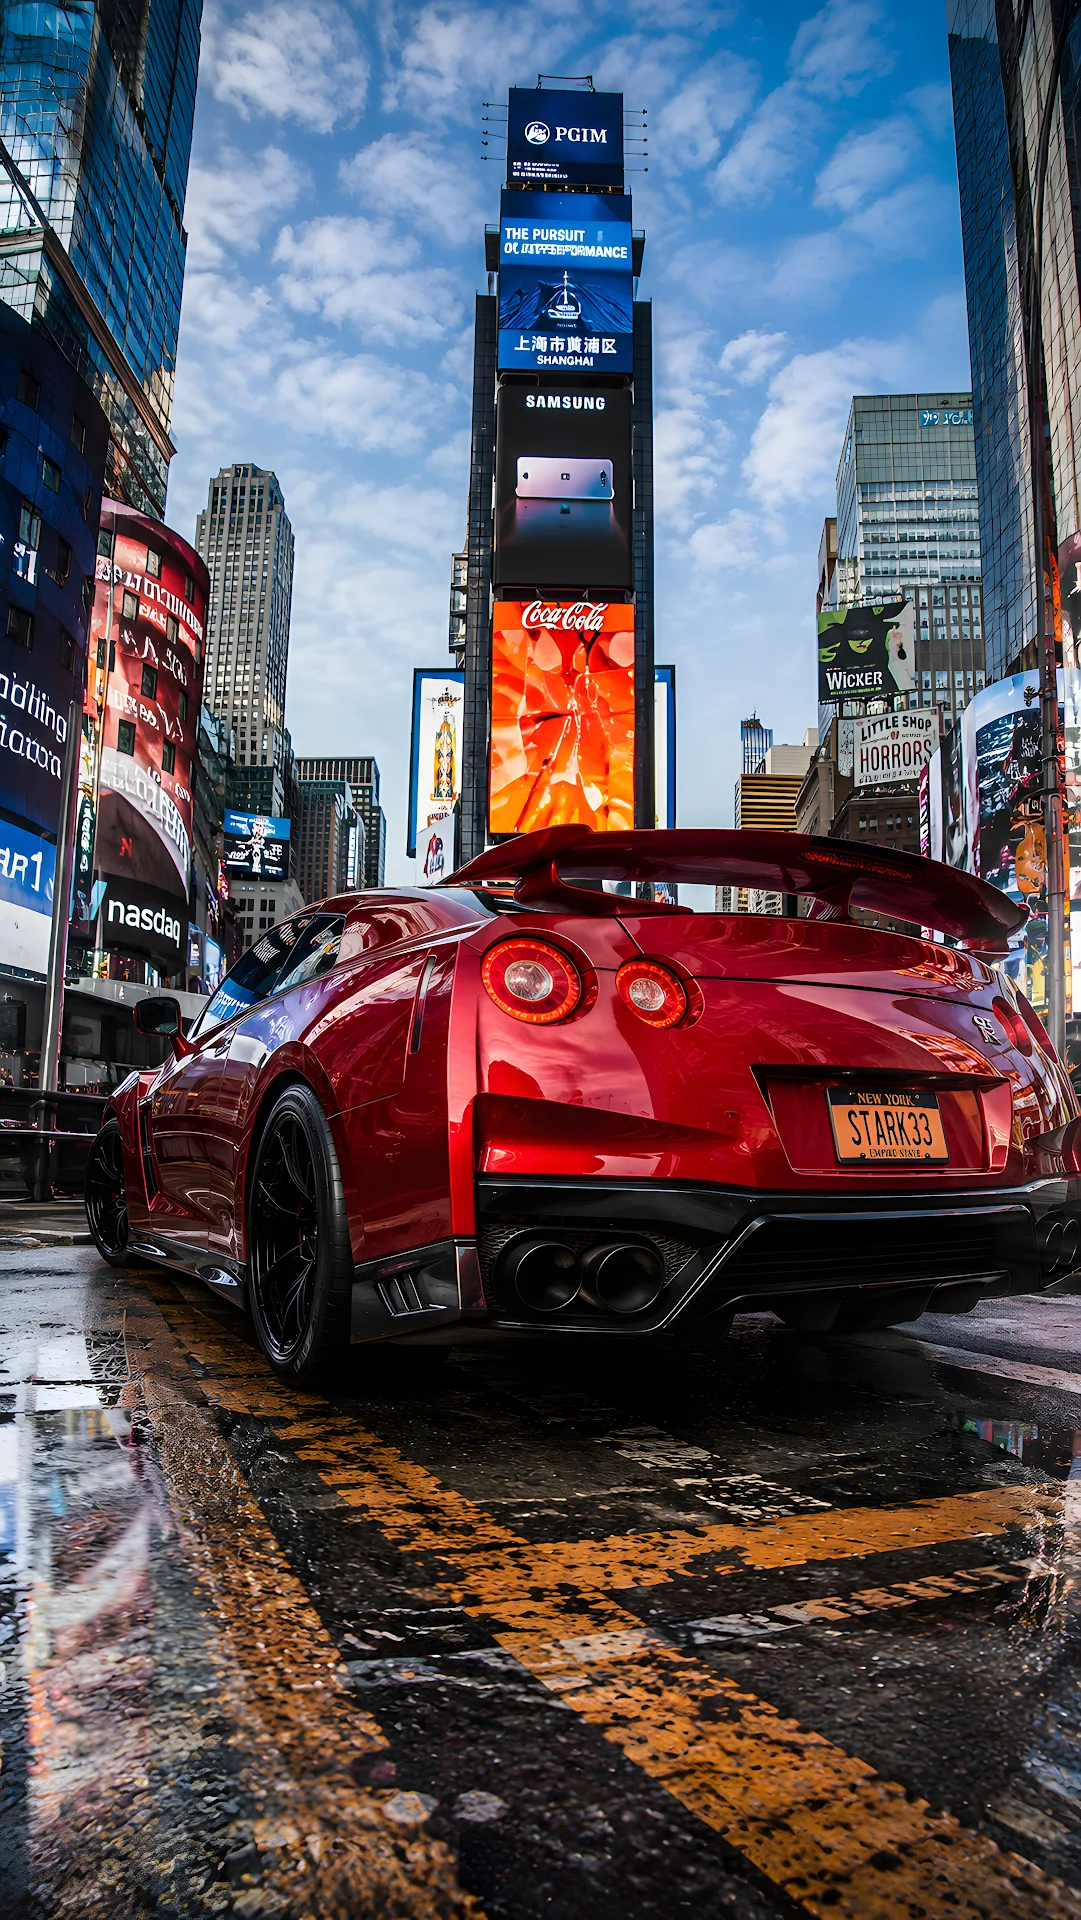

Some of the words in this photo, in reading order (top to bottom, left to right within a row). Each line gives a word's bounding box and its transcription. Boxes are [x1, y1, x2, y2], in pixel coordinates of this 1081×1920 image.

[555, 126, 608, 144] PGIM
[504, 227, 529, 241] THE
[532, 228, 586, 243] PURSUIT
[514, 335, 617, 354] 上海市黄浦区
[536, 354, 594, 367] SHANGHAI
[525, 394, 606, 411] SAMSUNG
[521, 600, 609, 632] Coca-Cola
[902, 715, 932, 732] SHOP
[860, 739, 932, 774] HORRORS
[107, 899, 181, 949] nasdaq
[856, 1092, 882, 1105] NEW
[884, 1093, 915, 1107] YORK
[847, 1109, 933, 1147] STARK33
